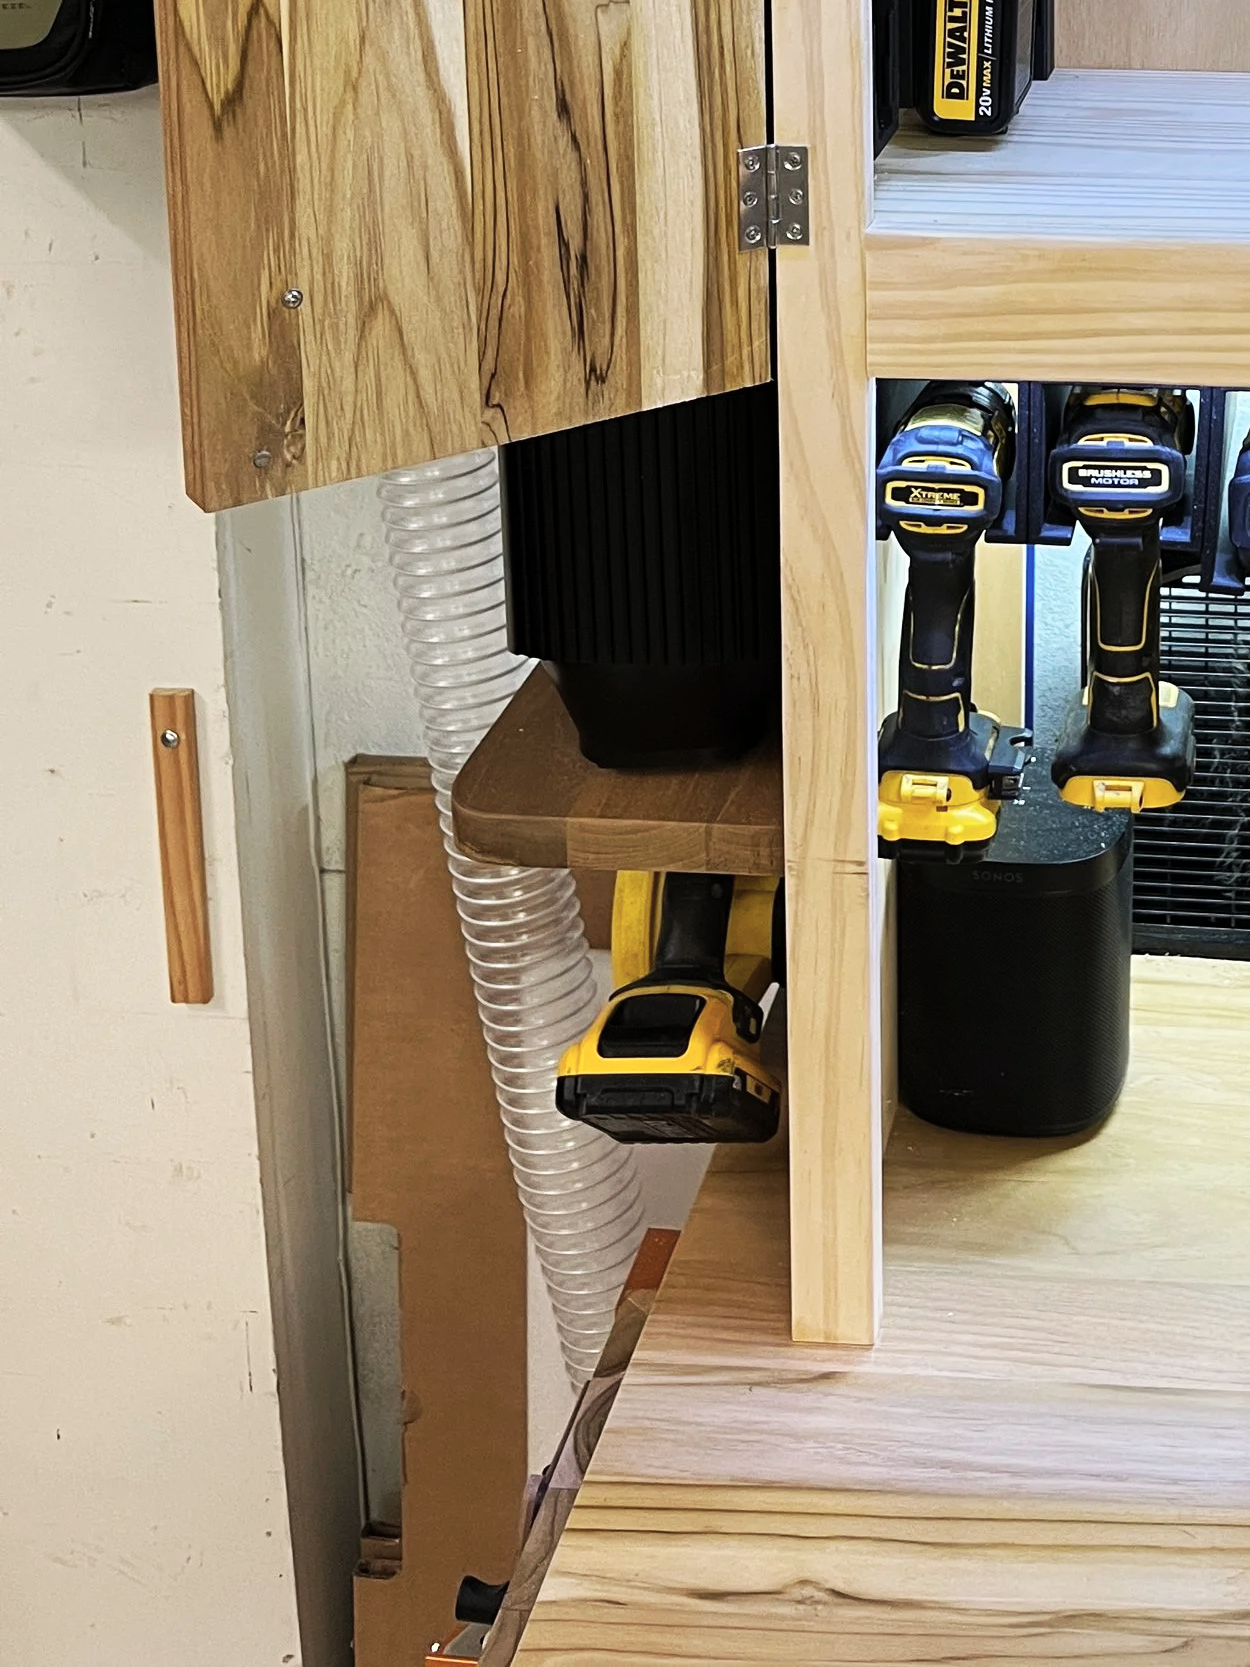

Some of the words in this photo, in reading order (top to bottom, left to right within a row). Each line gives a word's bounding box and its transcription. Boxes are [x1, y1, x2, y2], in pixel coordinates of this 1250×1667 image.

[1078, 468, 1152, 479] BRUSHLESS
[1090, 477, 1139, 485] MOTOR
[972, 870, 1023, 883] SONOS
